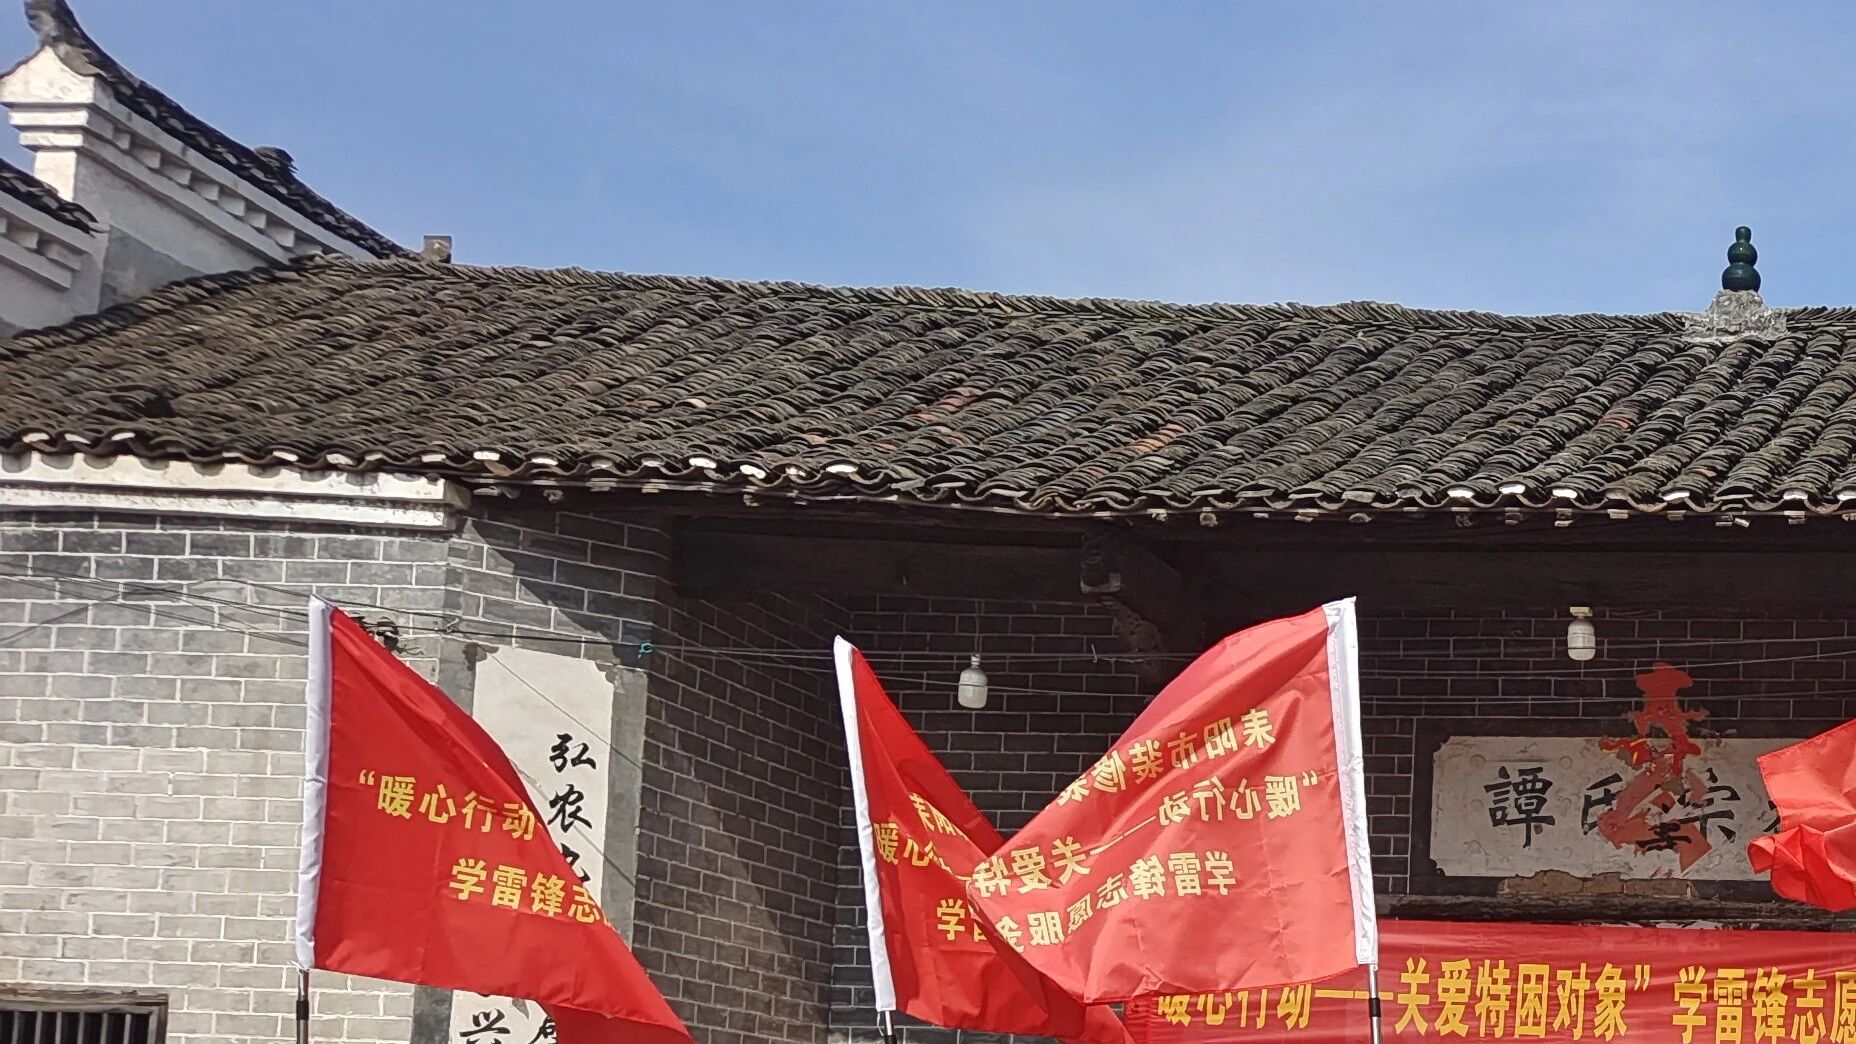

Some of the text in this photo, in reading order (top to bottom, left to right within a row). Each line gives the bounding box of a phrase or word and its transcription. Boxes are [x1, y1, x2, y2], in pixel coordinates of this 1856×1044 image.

[1484, 766, 1780, 848] 譚氏宗
[448, 857, 608, 927] 学雷锋志
